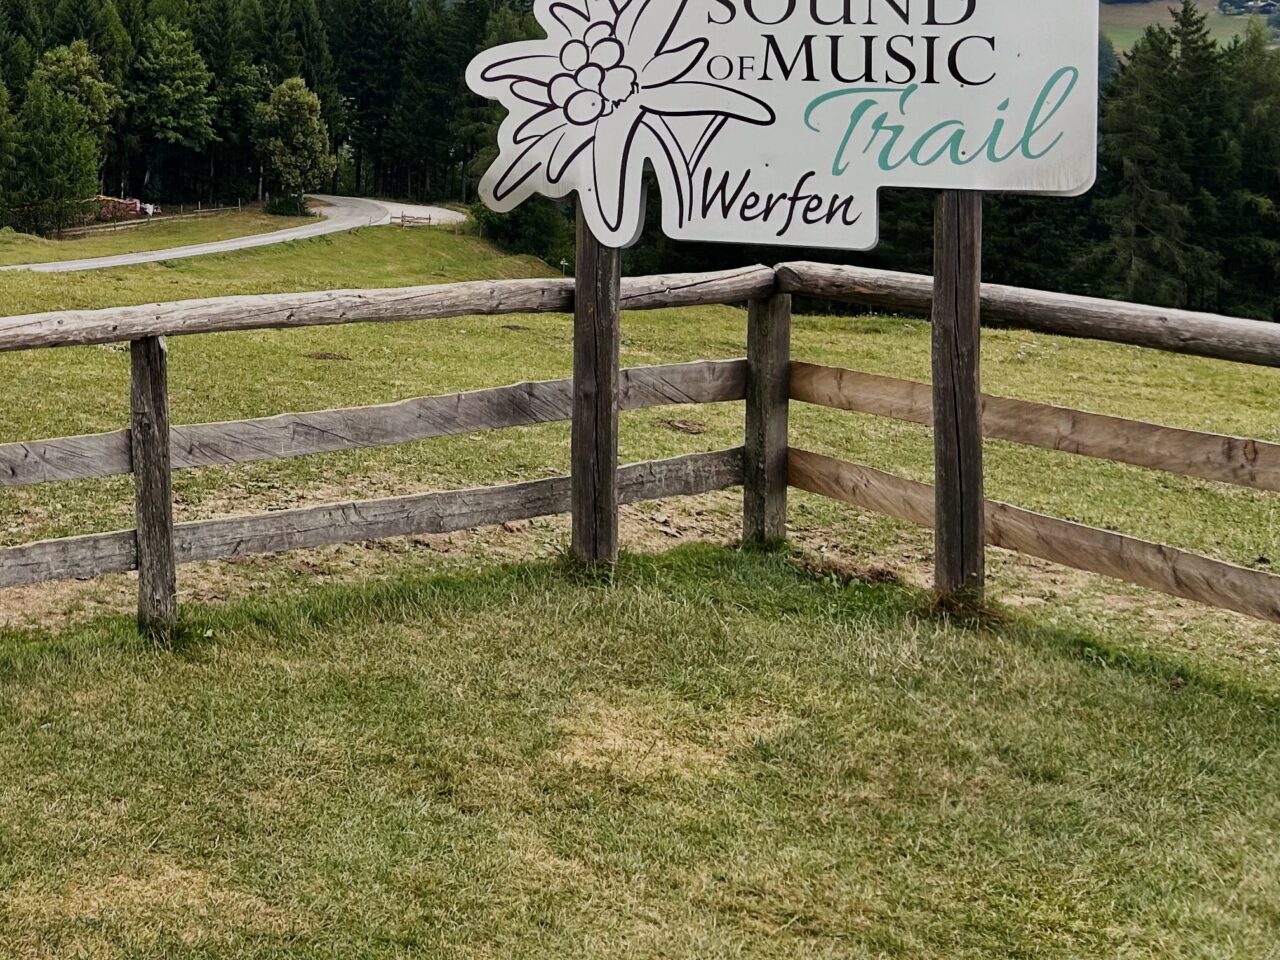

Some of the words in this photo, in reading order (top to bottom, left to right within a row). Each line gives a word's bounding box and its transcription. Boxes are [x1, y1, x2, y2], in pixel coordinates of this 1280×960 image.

[706, 55, 757, 81] OF
[757, 34, 997, 87] MUSIC
[803, 65, 1080, 177] Trail
[700, 167, 863, 237] Werfen
